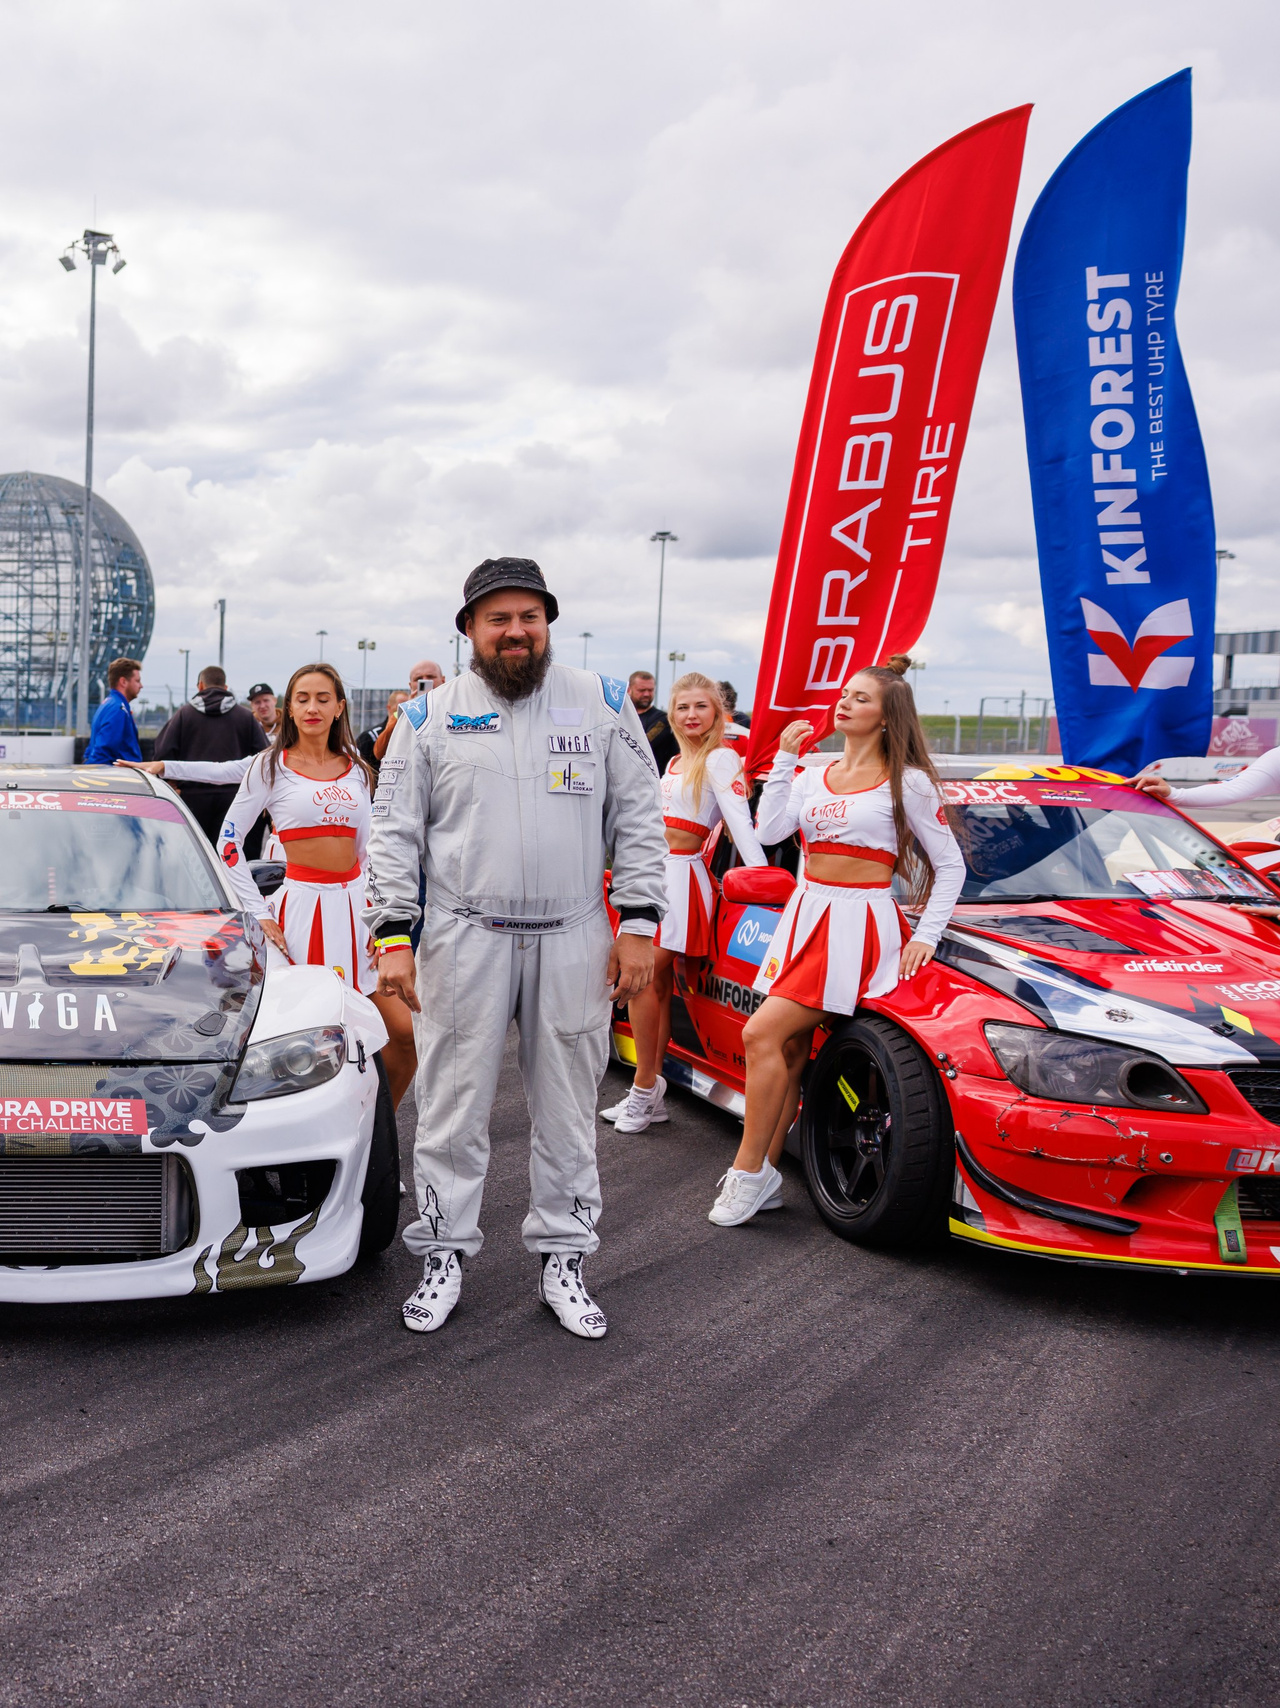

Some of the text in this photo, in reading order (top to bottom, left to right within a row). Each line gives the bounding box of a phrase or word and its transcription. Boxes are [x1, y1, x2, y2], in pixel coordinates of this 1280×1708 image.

[1145, 270, 1167, 481] THE BEST UHP TYRE
[1085, 266, 1150, 585] KINFOREST
[805, 293, 919, 691] BRABUS
[900, 422, 955, 562] TIRE
[938, 785, 1027, 800] DDC
[77, 802, 127, 810] MATSURI
[321, 814, 350, 823] ДРАЙВ
[506, 919, 563, 930] ANTROPOV S.
[758, 931, 773, 944] НОР
[698, 961, 767, 1014] KINFORE
[1229, 980, 1280, 994] IGO
[50, 1101, 133, 1118] DRIVE
[16, 1117, 134, 1132] CHALLENGE
[402, 1305, 430, 1320] OMP
[584, 1313, 608, 1327] OM
